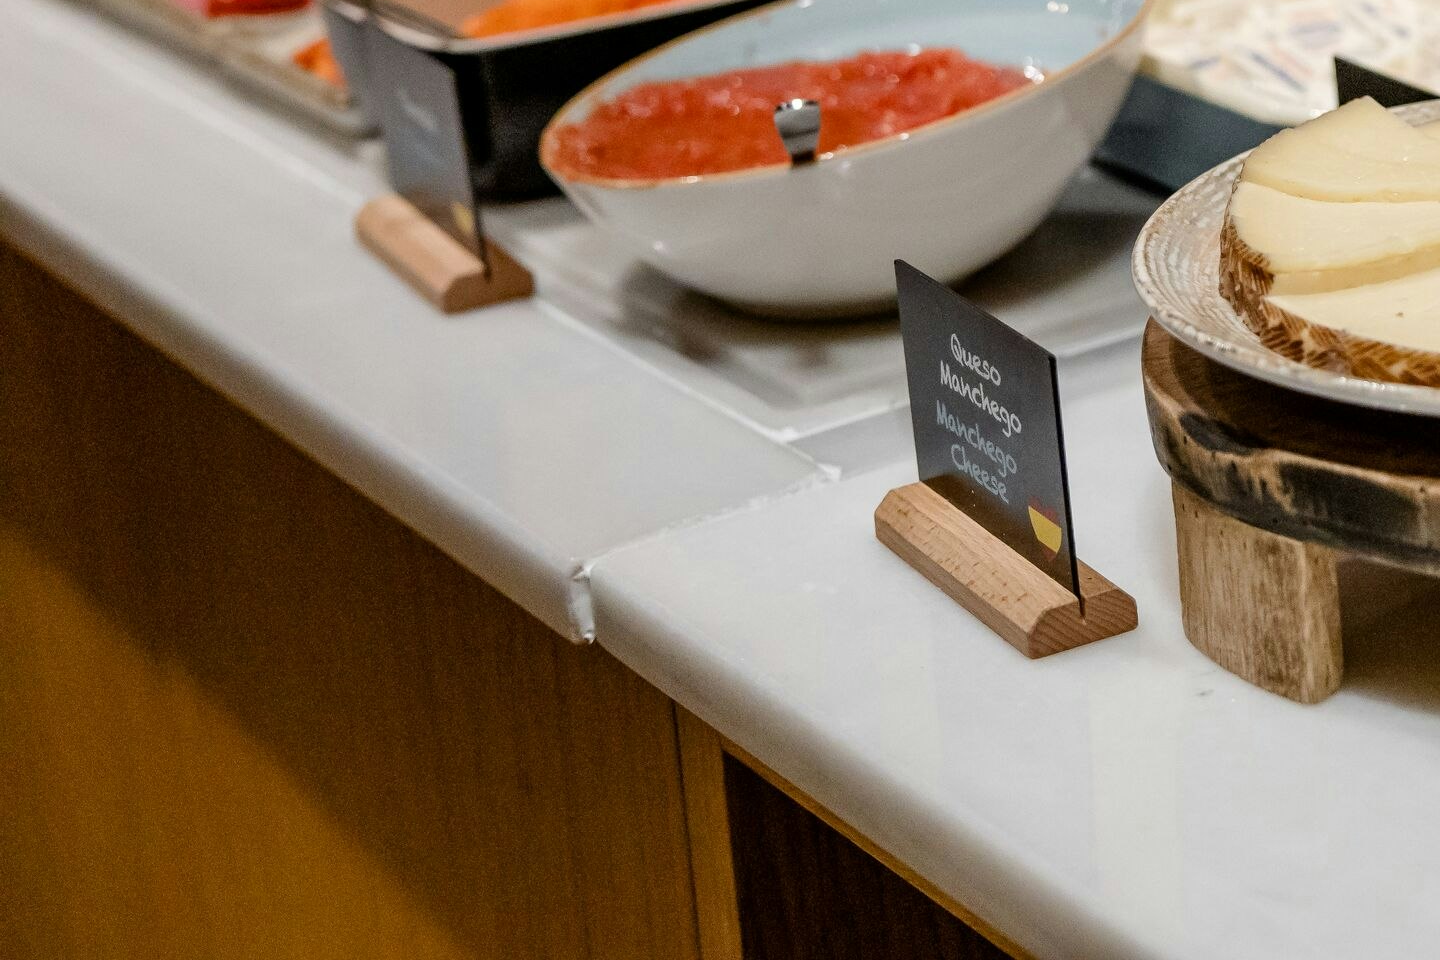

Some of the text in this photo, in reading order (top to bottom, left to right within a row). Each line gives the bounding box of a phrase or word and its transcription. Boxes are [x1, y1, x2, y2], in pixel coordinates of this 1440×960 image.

[950, 333, 1002, 386] Queso
[940, 359, 1022, 438] Manchego
[936, 399, 1018, 478] Manchego
[950, 443, 1010, 505] Cheese
